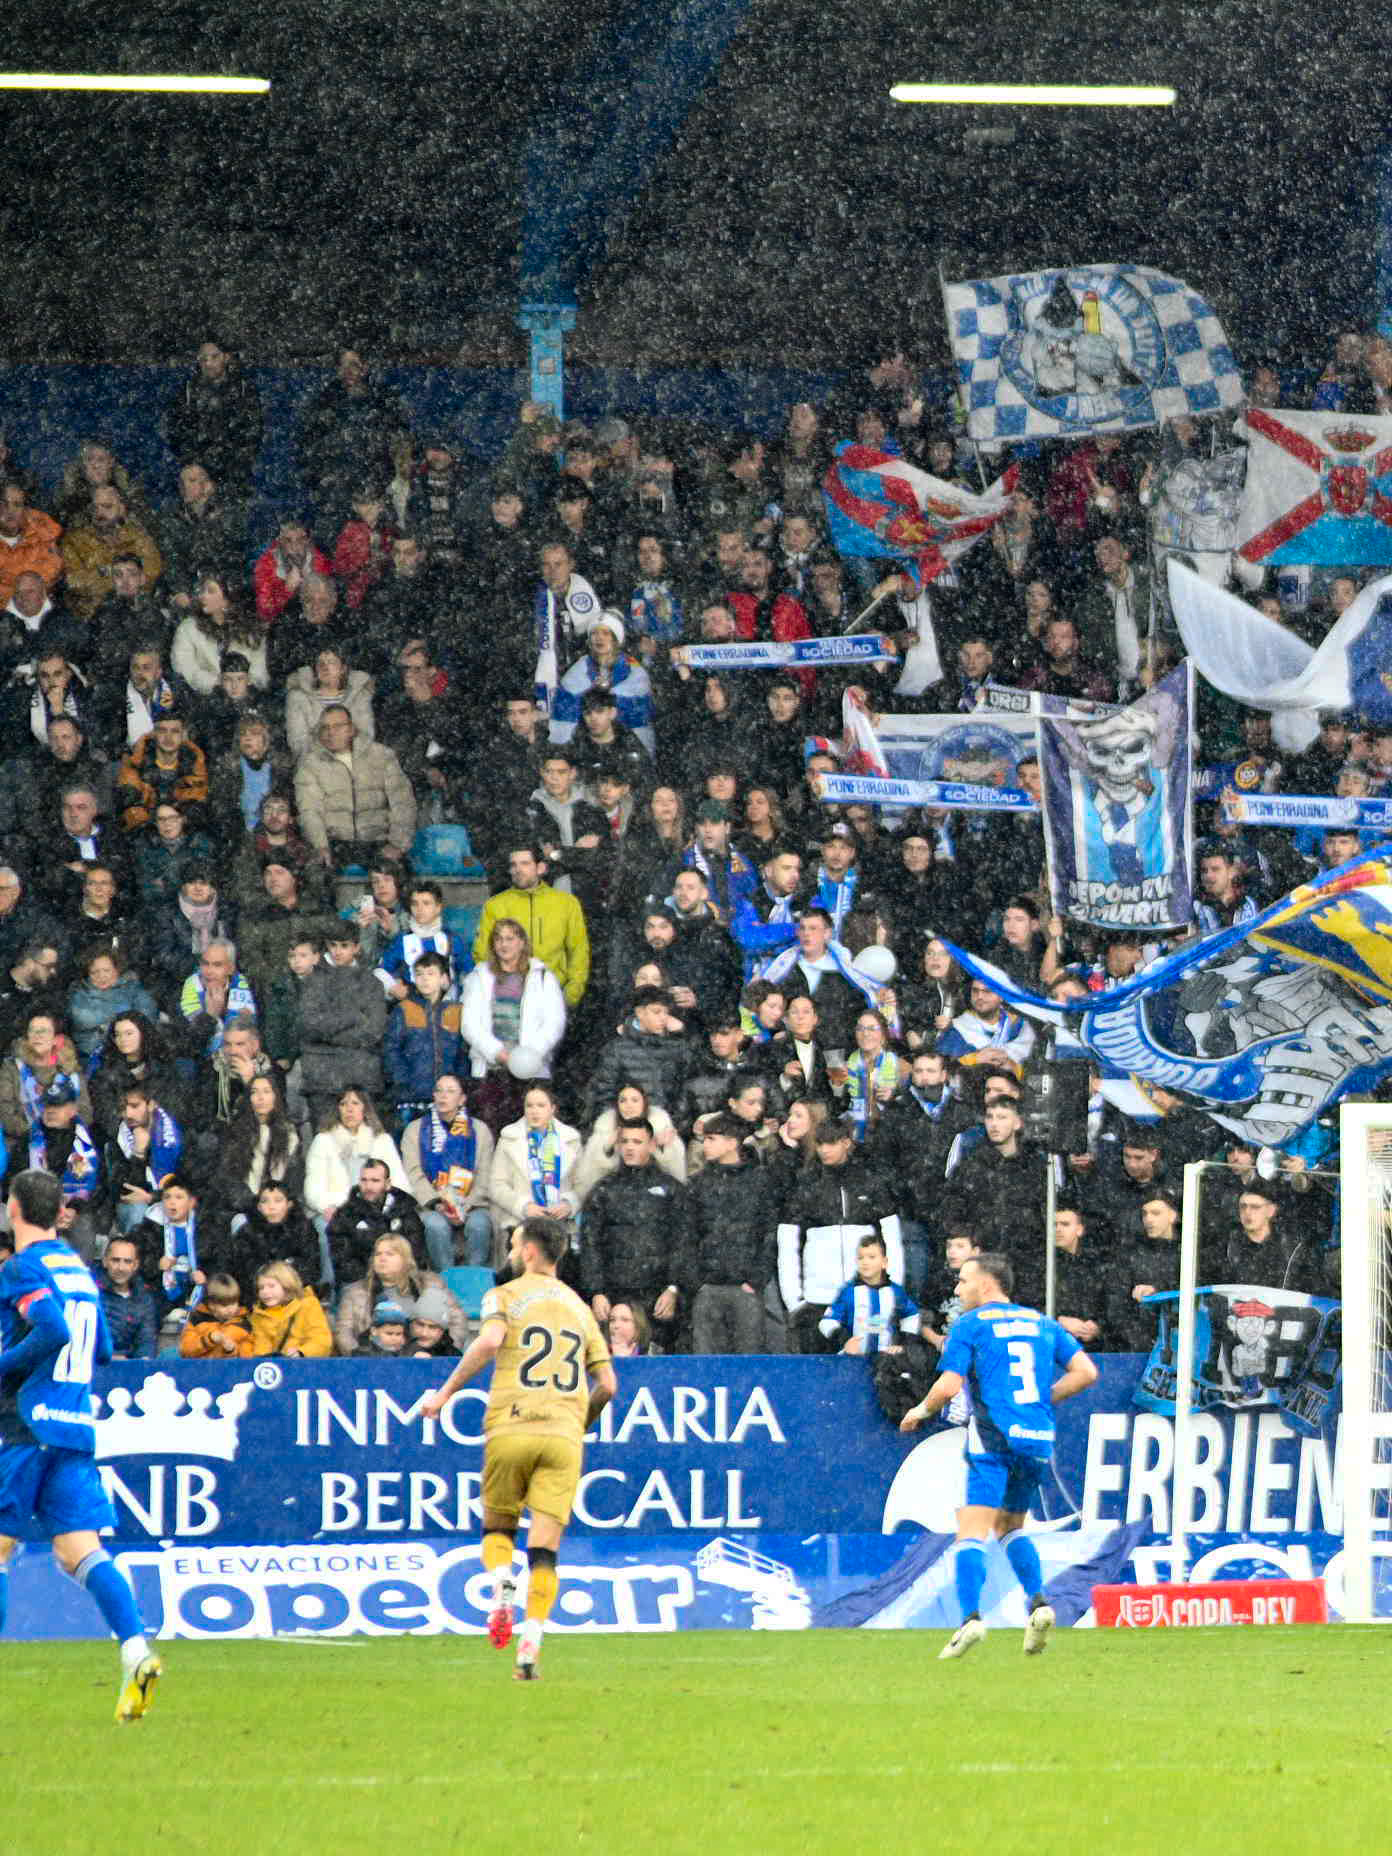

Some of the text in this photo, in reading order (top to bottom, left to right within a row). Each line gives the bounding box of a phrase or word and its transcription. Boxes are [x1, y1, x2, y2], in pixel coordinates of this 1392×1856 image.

[518, 1325, 582, 1394] 23
[1006, 1341, 1041, 1405] 3
[320, 1469, 762, 1531] BERRCALL
[174, 1555, 425, 1575] ELEVACIONES
[1172, 1598, 1233, 1625] COPA
[1252, 1597, 1297, 1625] REY
